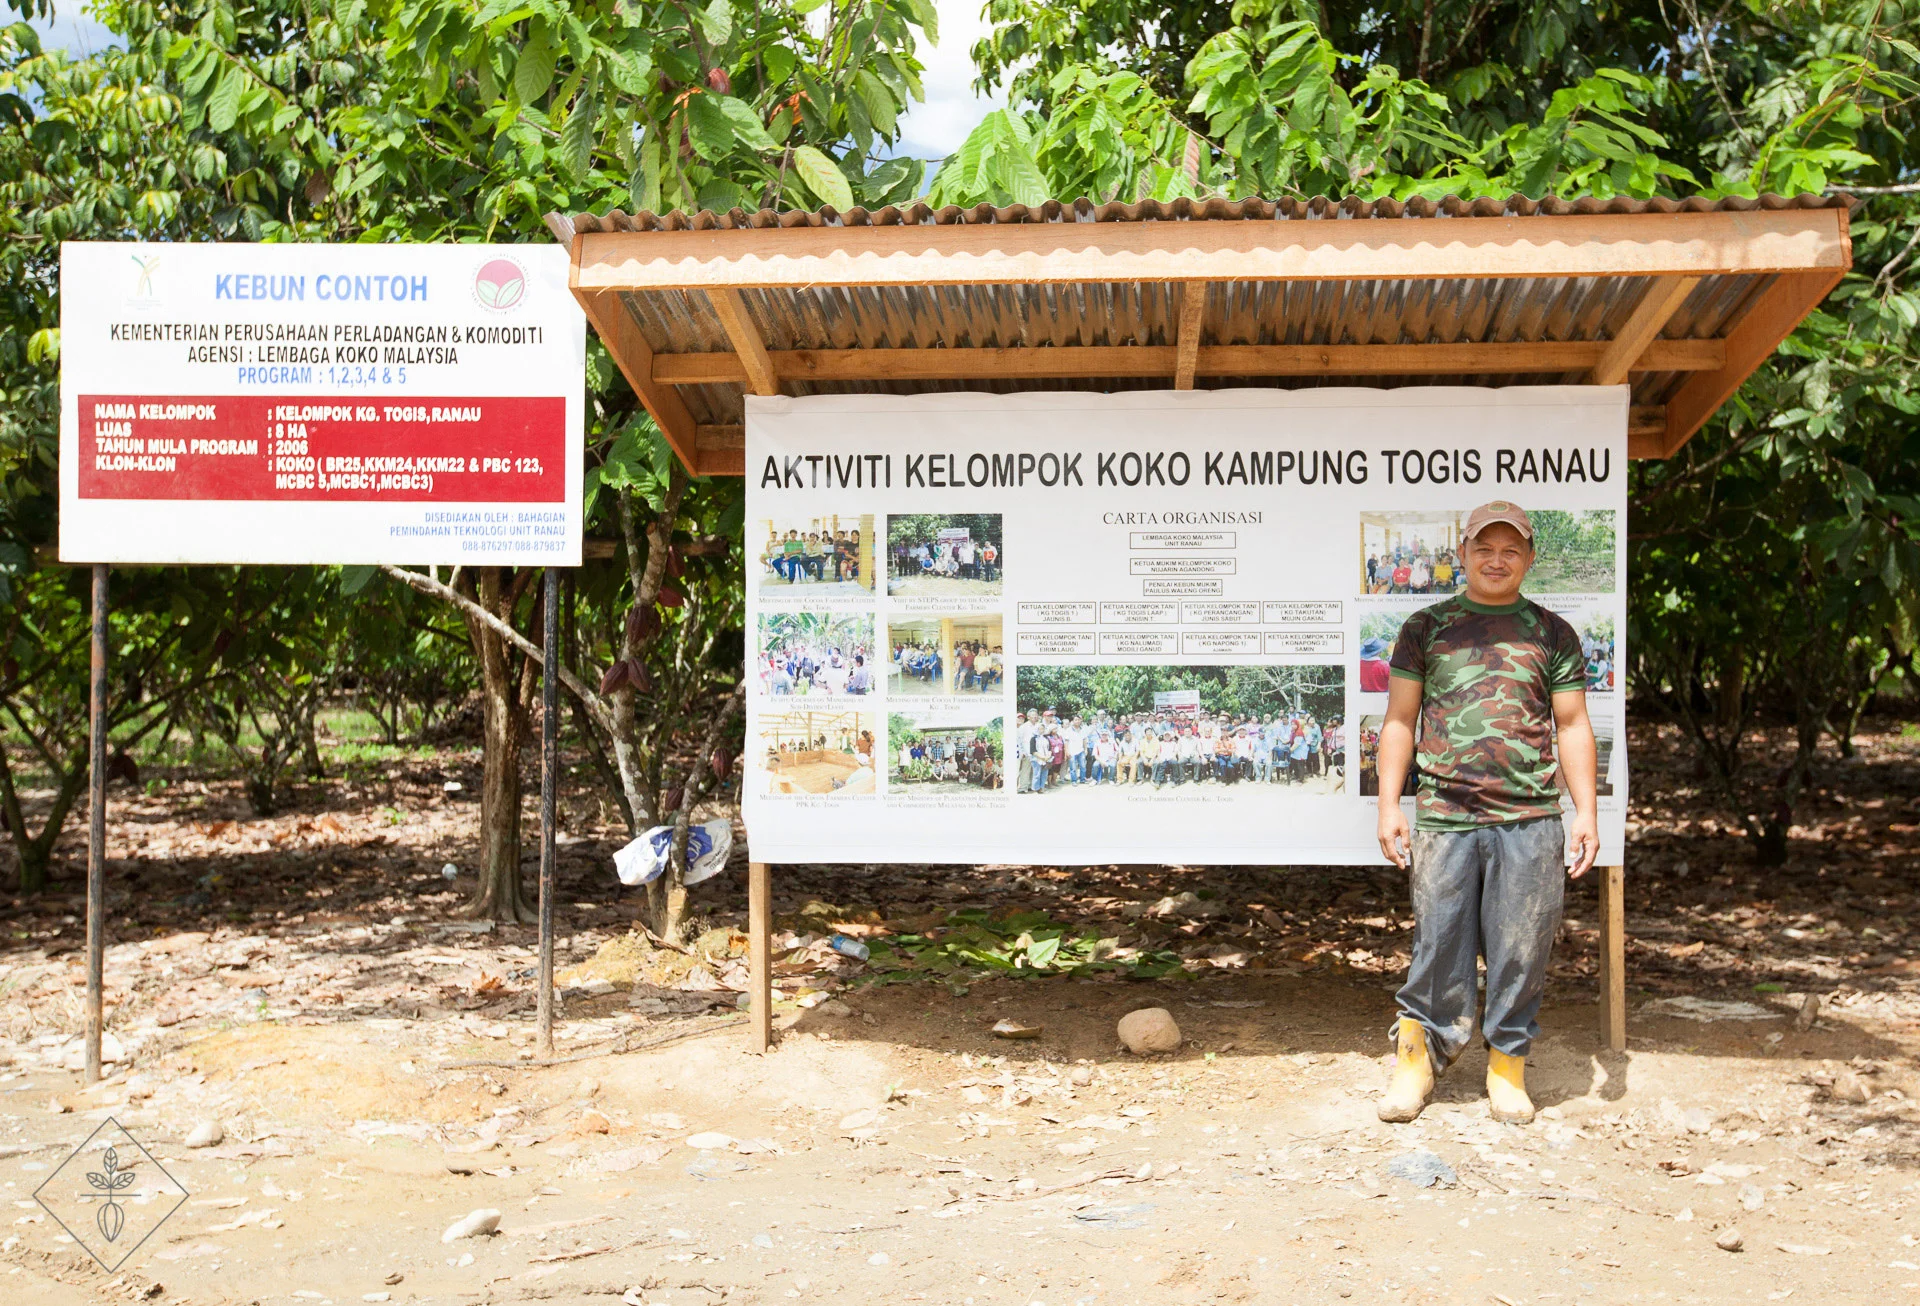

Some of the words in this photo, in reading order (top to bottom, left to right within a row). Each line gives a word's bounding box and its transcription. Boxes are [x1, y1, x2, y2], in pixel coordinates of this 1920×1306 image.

[215, 274, 305, 302] KEBUN
[316, 274, 428, 302] CONTOH
[111, 324, 219, 342] KEMENTERIAN
[224, 324, 328, 342] PERUSAHAAN
[335, 324, 447, 342] PERLADANGAN
[451, 326, 462, 342] &
[466, 326, 543, 344] KOMODITI
[188, 346, 243, 364] AGENSI
[258, 346, 330, 364] LEMBAGA
[336, 346, 378, 364] KOKO
[384, 346, 458, 364] MALAYSIA
[238, 366, 312, 384] PROGRAM
[328, 366, 377, 388] 1,2,3,4
[382, 366, 392, 384] &
[398, 366, 406, 384] 5
[94, 404, 136, 420] NAMA
[139, 404, 217, 420] KELOMPOK
[275, 406, 352, 422] KELOMPOK
[355, 406, 381, 422] KG.
[95, 422, 133, 438] LUAS
[275, 424, 284, 438] 8
[287, 424, 307, 438] HA
[95, 438, 144, 454] TAHUN
[147, 438, 187, 454] MULA
[190, 438, 258, 454] PROGRAM
[275, 440, 308, 456] 2006
[95, 456, 176, 472] KLON-KLON
[276, 456, 316, 472] KOKO
[325, 456, 464, 476] BR25,KKM24,KKM22
[469, 458, 479, 474] &
[483, 458, 511, 474] PBC
[515, 458, 544, 476] 123,
[760, 454, 891, 488] AKTIVITI
[905, 454, 1083, 488] KELOMPOK
[1097, 452, 1190, 486] KOKO
[1204, 450, 1368, 486] KAMPUNG
[1381, 448, 1482, 484] TOGIS
[1496, 448, 1611, 484] RANAU
[276, 474, 316, 490] MCBC
[425, 512, 481, 522] DISEDIAKAN
[484, 512, 508, 522] OLEH
[518, 512, 565, 522] BAHAGIAN
[1103, 511, 1158, 525] CARTA
[1162, 511, 1263, 525] ORGANISASI
[390, 526, 451, 536] PEMINDAHAN
[454, 526, 506, 536] TEKNOLOGI
[509, 526, 531, 536] UNIT
[534, 526, 565, 536] RANAU
